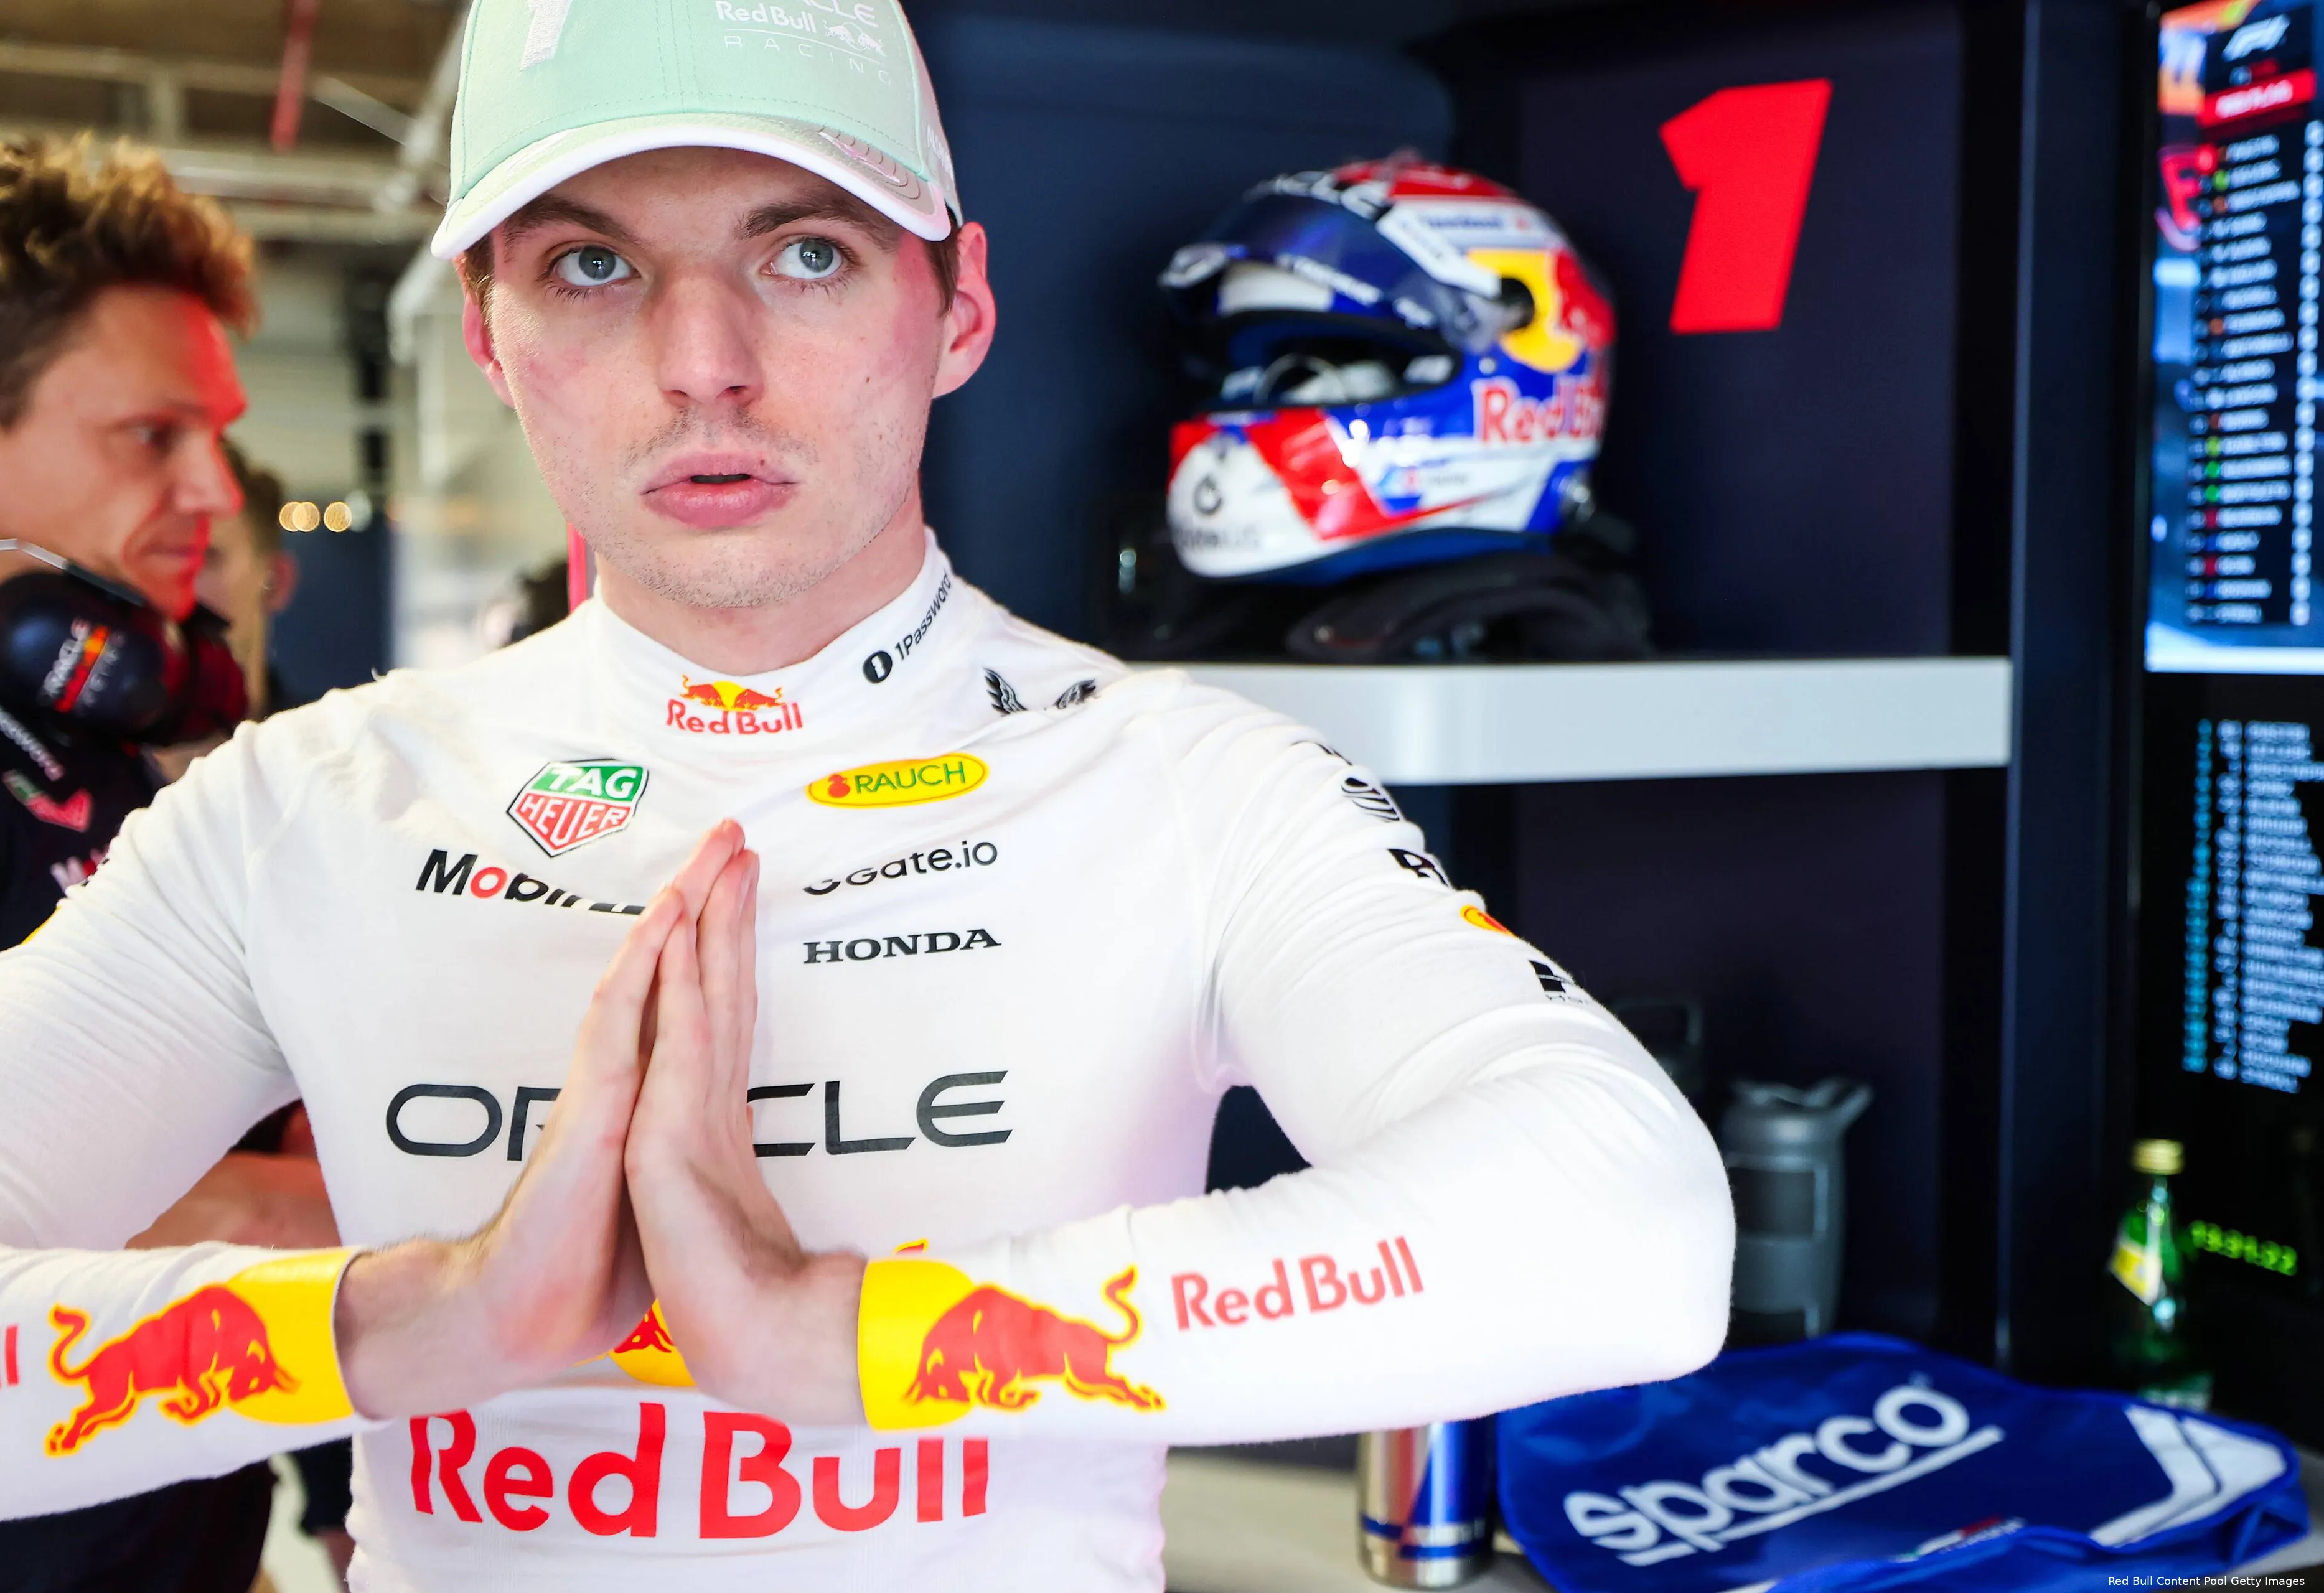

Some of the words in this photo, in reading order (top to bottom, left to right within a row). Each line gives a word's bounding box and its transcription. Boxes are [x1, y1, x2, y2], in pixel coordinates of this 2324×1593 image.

[715, 1, 769, 24] Red
[769, 5, 817, 33] Bull
[724, 35, 891, 85] RACING
[1659, 78, 1832, 334] 1
[894, 569, 952, 661] 1Password
[666, 699, 730, 734] Red
[736, 703, 803, 734] Bull
[547, 767, 637, 798] TAG
[854, 761, 967, 794] RAUCH
[521, 795, 627, 846] HEUER
[804, 929, 1001, 964] HONDA
[387, 1070, 1013, 1161] OCLE
[1171, 1258, 1295, 1331] Red
[1299, 1236, 1423, 1313] Bull
[409, 1401, 667, 1538] Red
[698, 1411, 990, 1539] Bull
[1563, 1386, 1970, 1553] sparco
